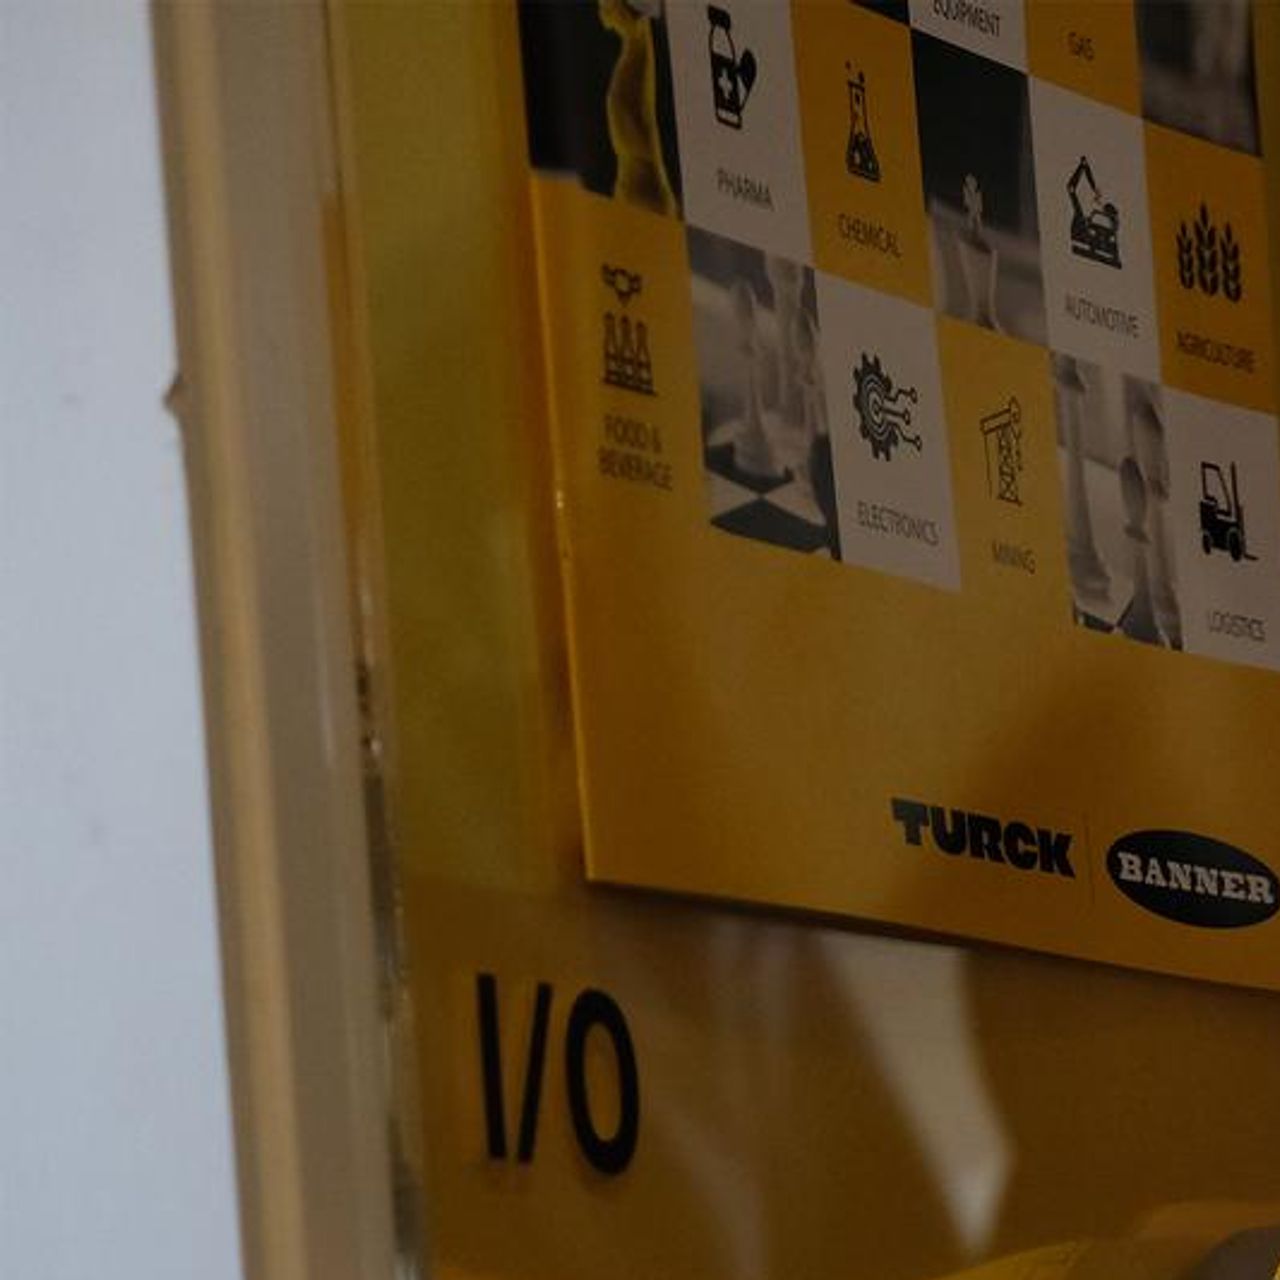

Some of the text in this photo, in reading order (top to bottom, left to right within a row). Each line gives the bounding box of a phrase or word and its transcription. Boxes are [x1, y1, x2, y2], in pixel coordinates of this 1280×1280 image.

[715, 167, 774, 212] PHARMA
[838, 213, 901, 258] CHEMICAL
[1065, 293, 1138, 339] AUTOMOTIVE
[1176, 330, 1254, 374] AGRICULTURE
[602, 413, 649, 450] FOOD
[597, 445, 673, 491] BEVERAGE
[857, 500, 940, 546] ELECTRONICS
[991, 539, 1036, 574] MINING
[1207, 609, 1266, 642] LOGISTICS
[891, 797, 1076, 879] TURCK
[1116, 850, 1276, 906] BANNER
[477, 973, 639, 1174] I/O
